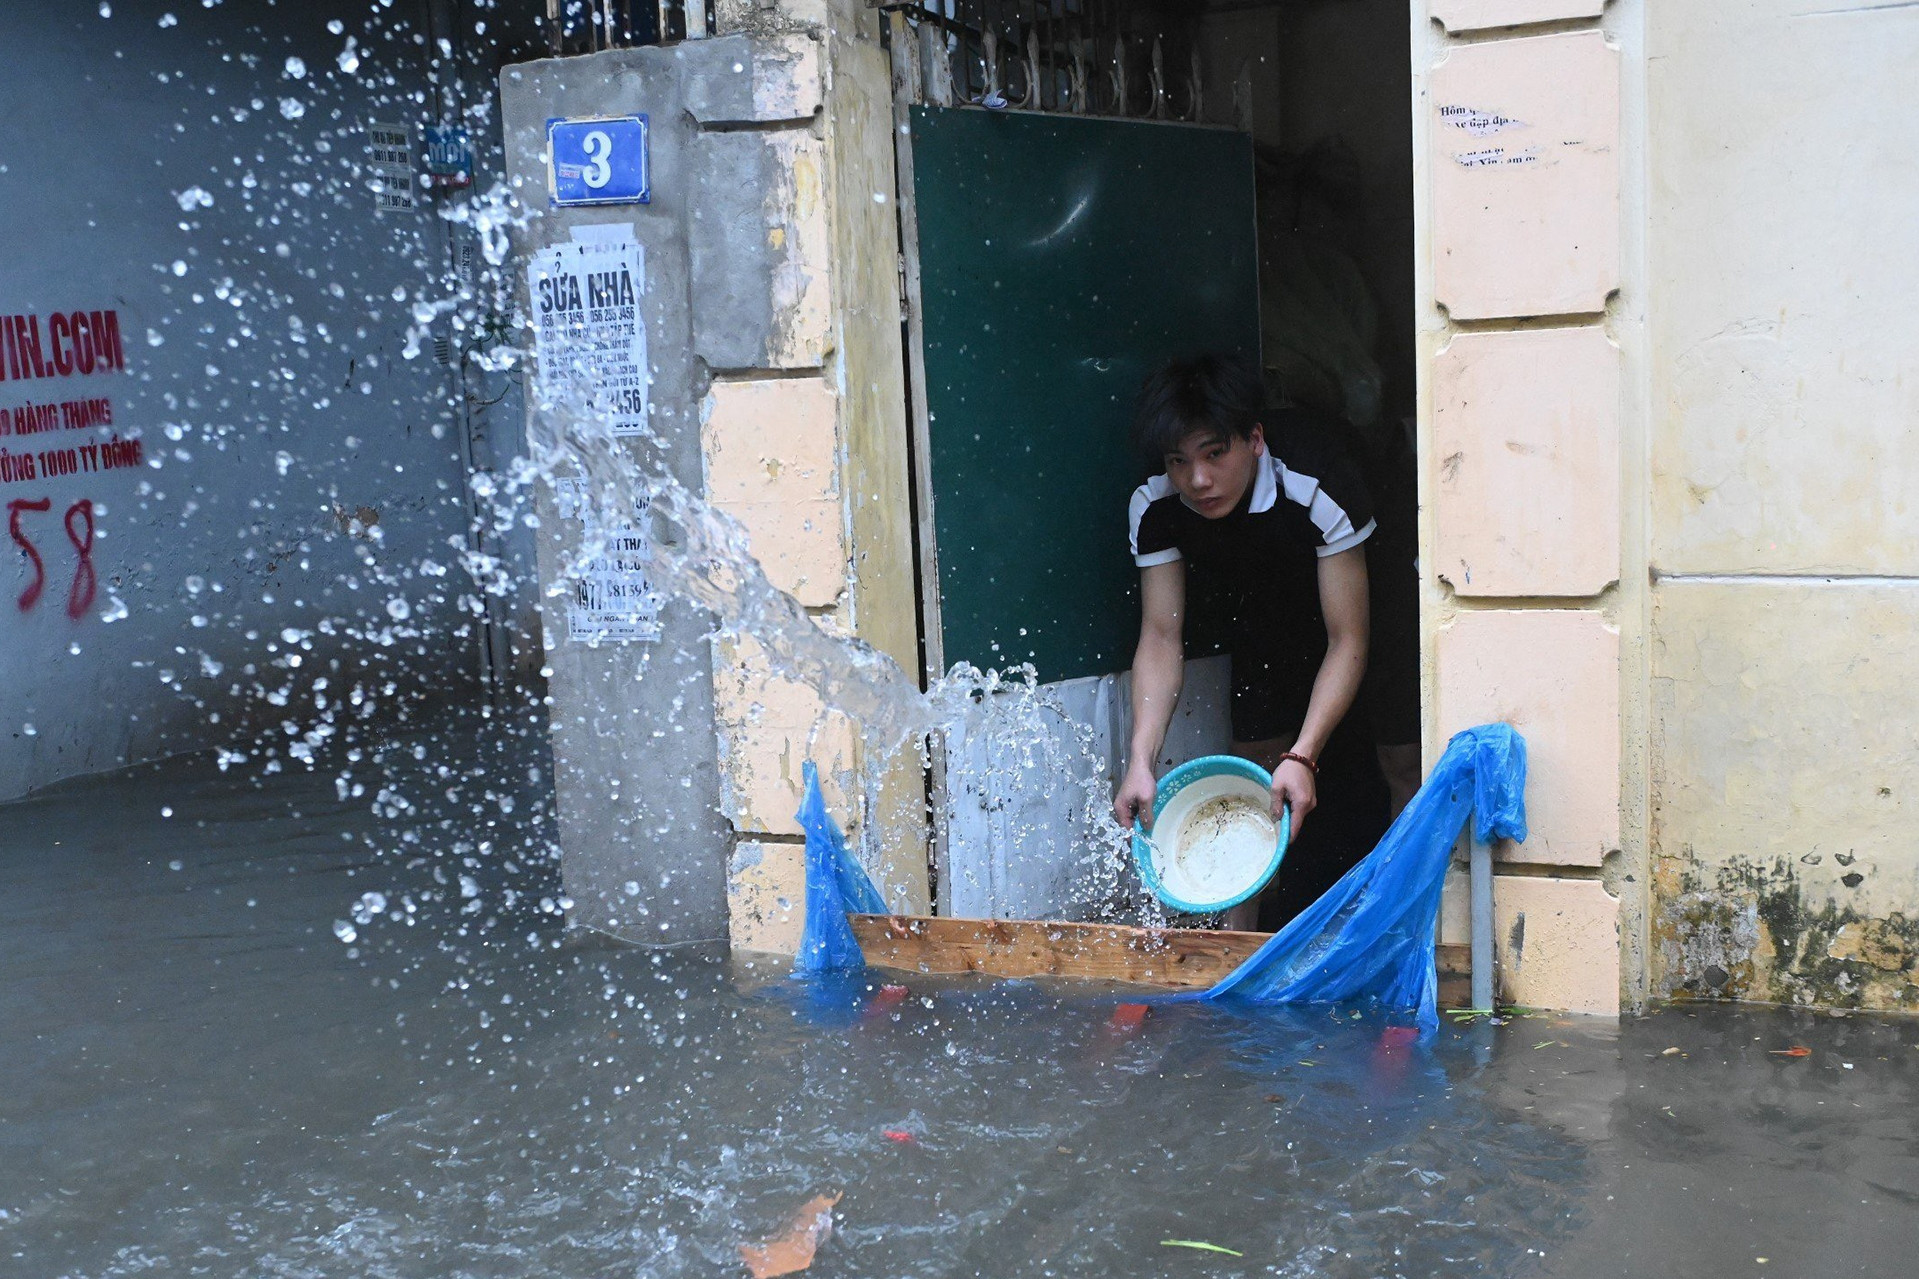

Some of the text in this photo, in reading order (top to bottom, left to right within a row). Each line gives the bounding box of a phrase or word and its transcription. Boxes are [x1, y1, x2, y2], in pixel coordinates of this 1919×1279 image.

[1441, 105, 1466, 116] Hôm
[583, 131, 612, 189] 3
[538, 260, 583, 313] SỬA
[587, 261, 635, 308] NHÀ
[14, 400, 59, 435] HÀNG
[38, 449, 77, 478] 1000
